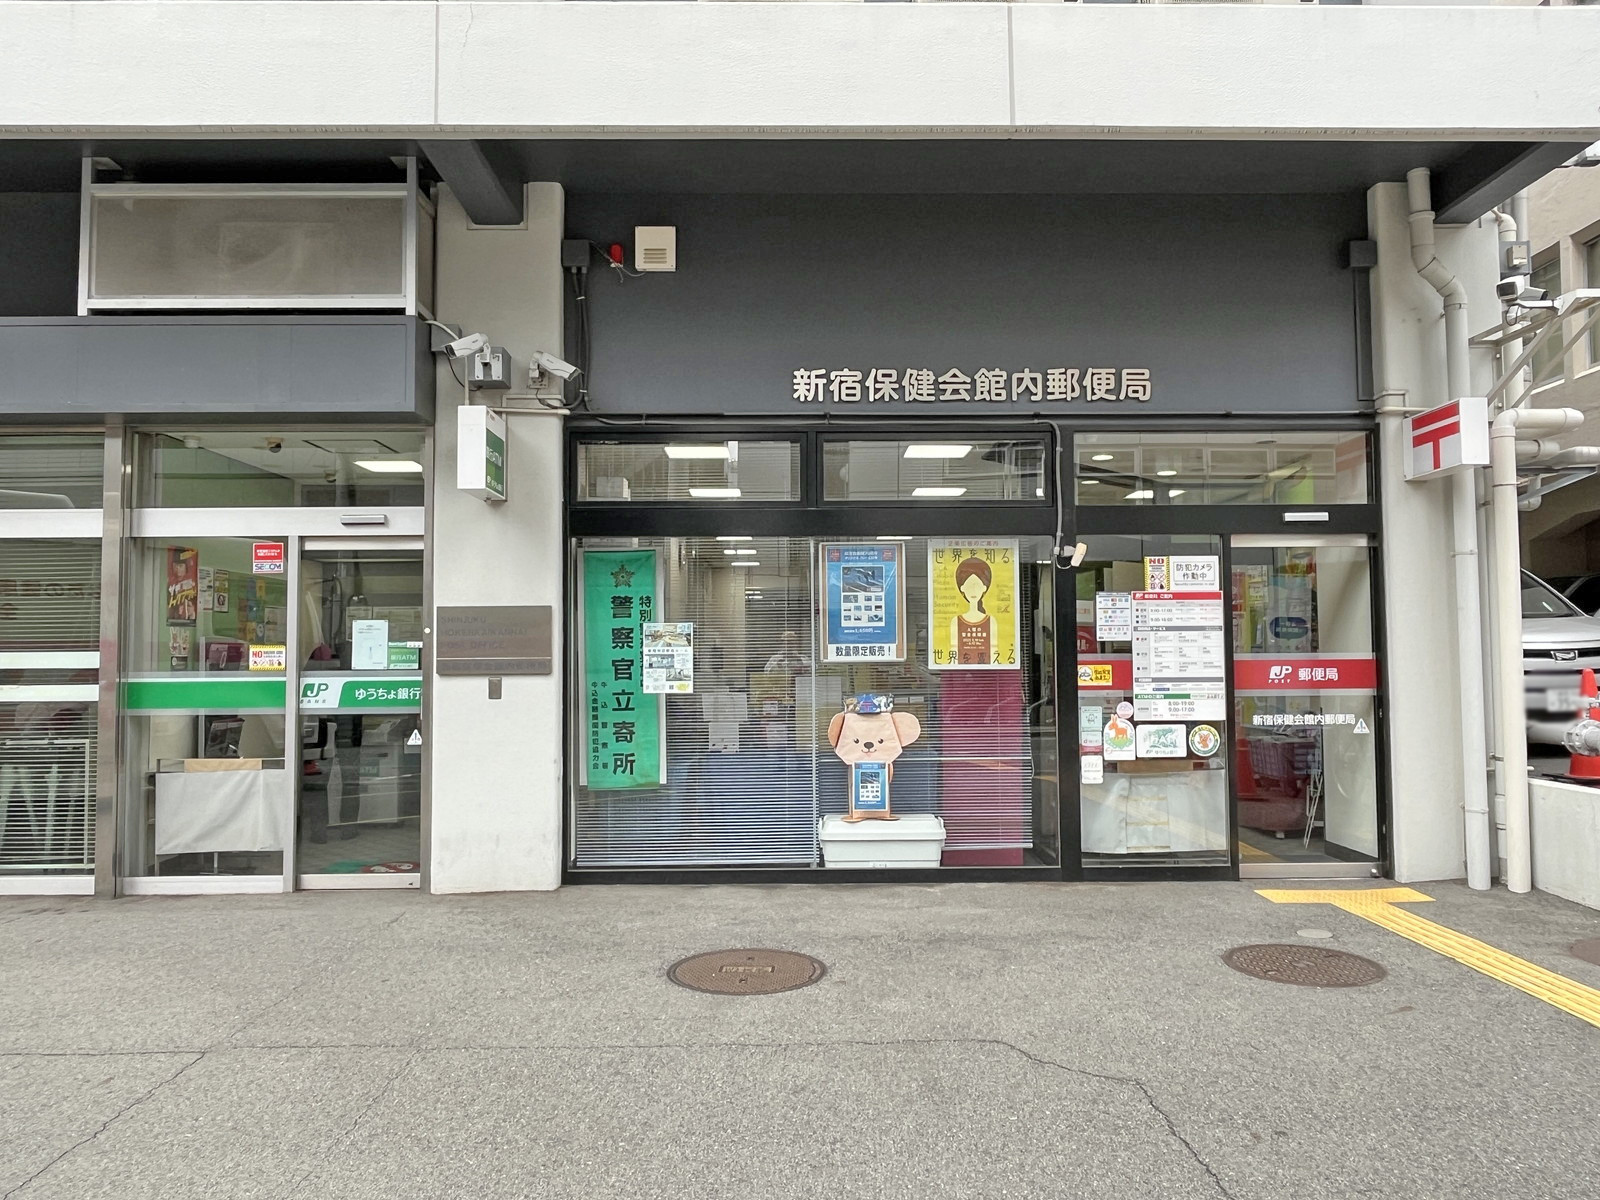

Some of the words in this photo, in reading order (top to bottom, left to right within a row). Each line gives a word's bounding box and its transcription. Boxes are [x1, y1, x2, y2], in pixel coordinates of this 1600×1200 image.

[792, 367, 1153, 403] 新宿保健会館内郵便局
[254, 563, 282, 571] SECOM
[1175, 563, 1213, 572] 防犯カメラ
[1182, 572, 1207, 580] 作動中
[835, 645, 891, 657] 数量限定販売！
[1298, 668, 1339, 681] 郵便局
[610, 595, 636, 776] 警察官立寄所
[355, 687, 421, 700] ゆうちょ銀行
[1252, 713, 1356, 726] 新宿保健会館内郵便局
